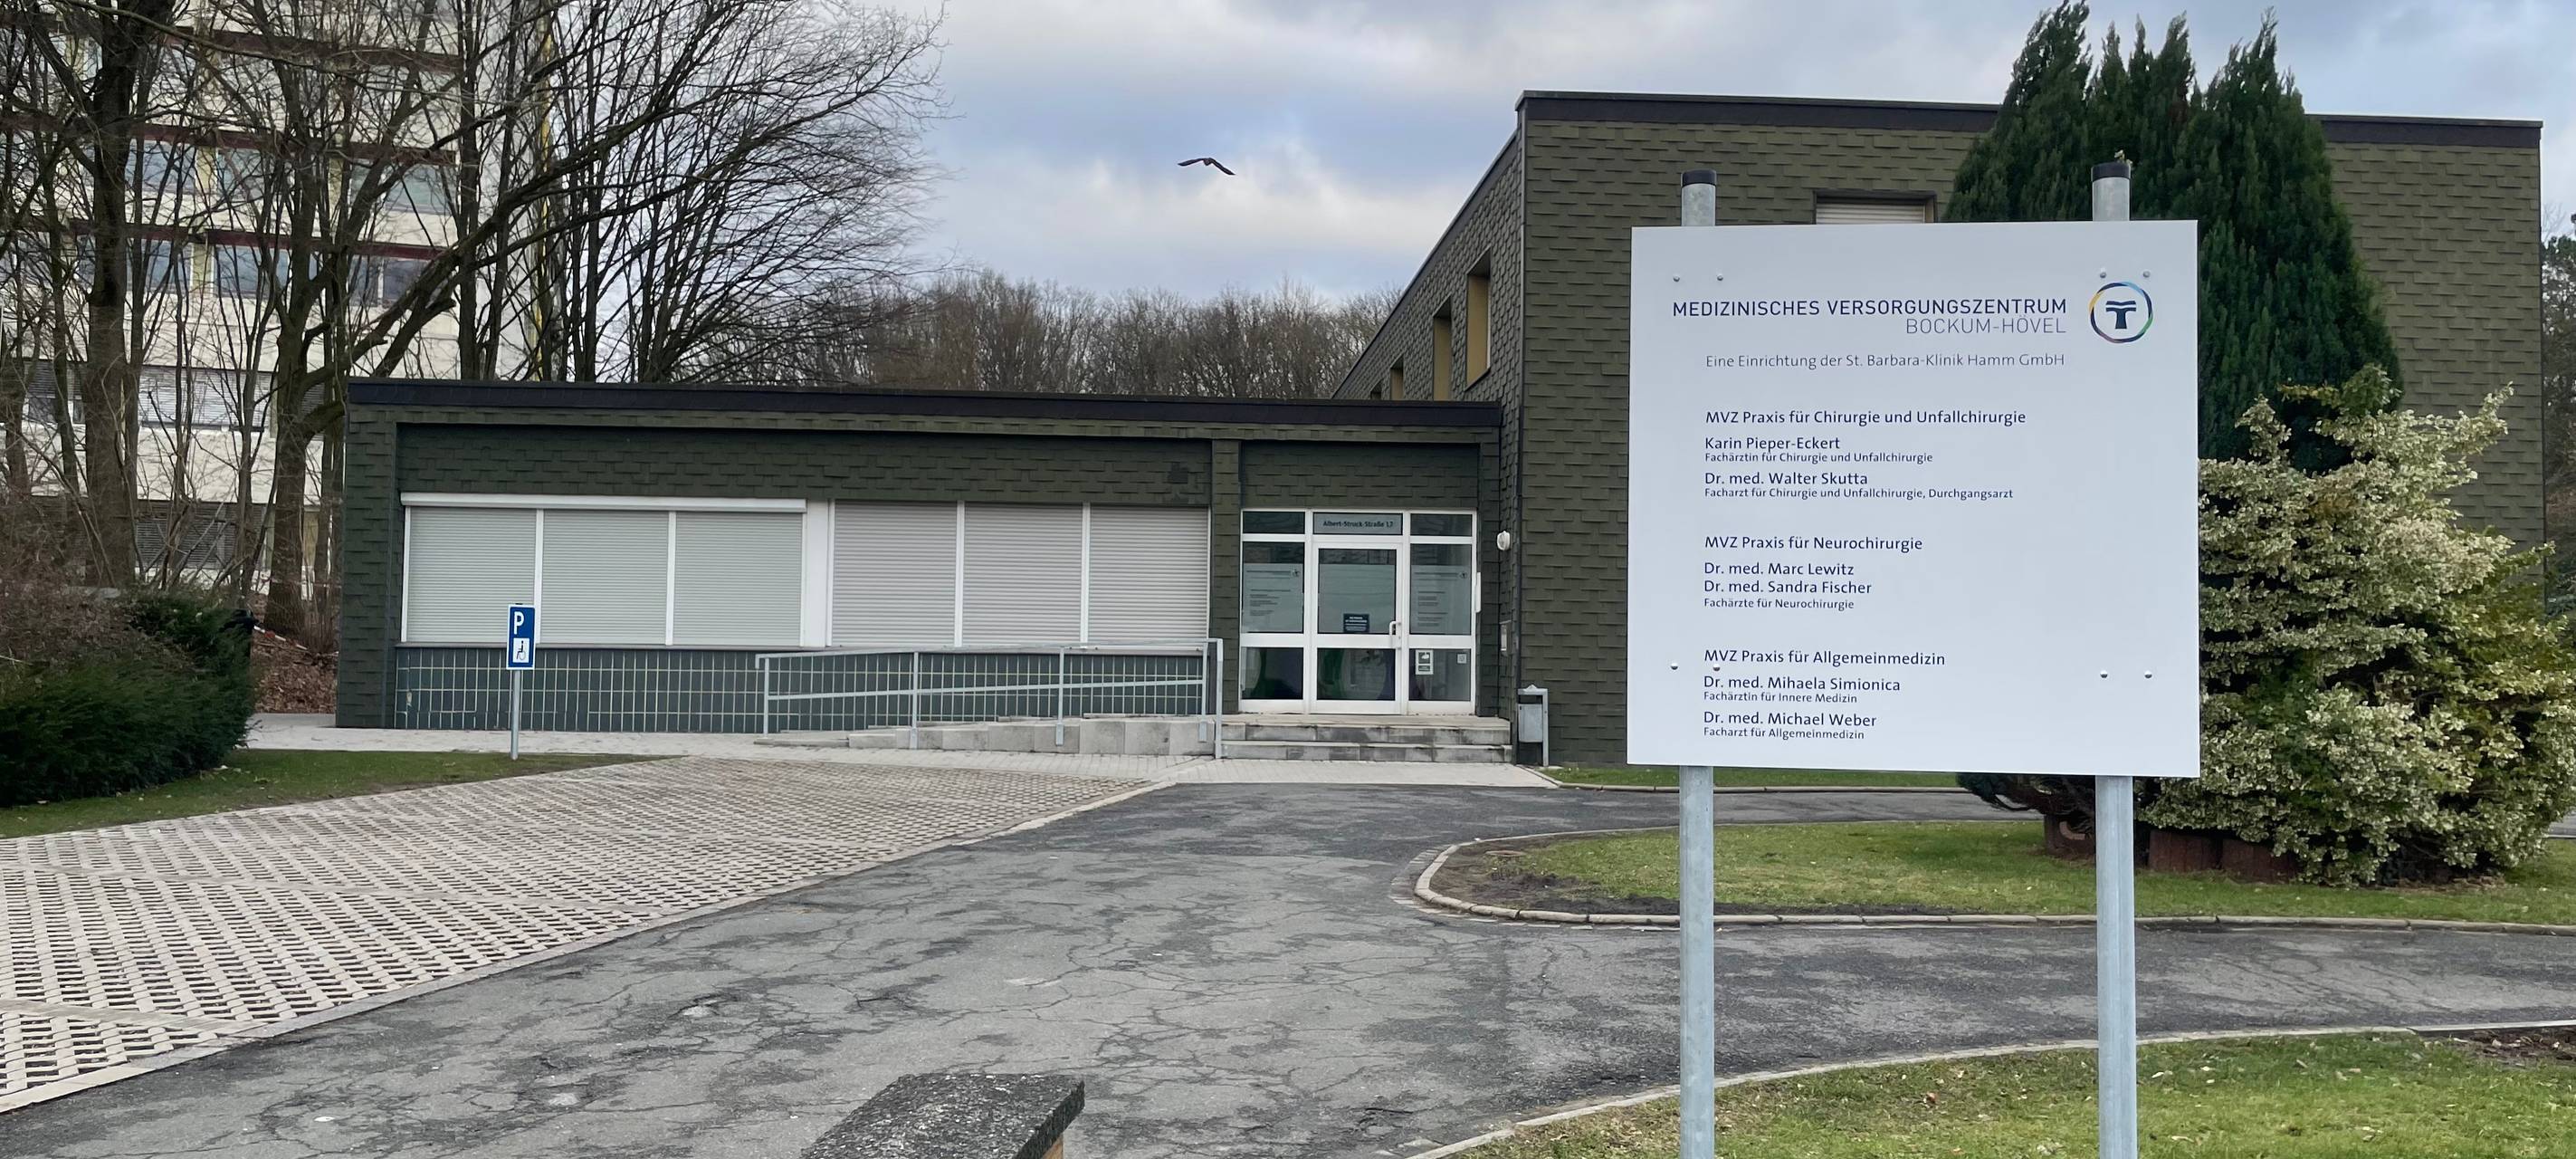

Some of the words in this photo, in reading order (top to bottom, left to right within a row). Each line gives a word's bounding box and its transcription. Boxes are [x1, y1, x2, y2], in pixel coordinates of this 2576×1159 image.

[1673, 300, 1820, 318] MEDIZINISCHES
[1827, 298, 2066, 316] VERSORGUNGSZENTRUM
[1906, 317, 2067, 334] BOCKUM-HÖVEL
[1706, 355, 1735, 368] Eine
[1738, 354, 1817, 371] Einrichtung
[1819, 354, 1843, 369] der
[1846, 354, 1864, 368] St.
[1867, 352, 1964, 368] Barbara-Klinik
[1967, 354, 2015, 368] Hamm
[2018, 352, 2065, 368] GmbH
[1705, 410, 1740, 424] MVZ
[1742, 410, 1786, 424] Praxis
[1788, 409, 1811, 424] für
[1813, 409, 1881, 427] Chirurgie
[1884, 409, 1913, 424] und
[1916, 409, 2027, 427] Unfallchirurgie
[1705, 436, 1742, 449] Karin
[1746, 436, 1841, 454] Pieper-Eckert
[1704, 451, 1759, 463] Fachärztin
[1761, 451, 1778, 463] für
[1779, 452, 1828, 465] Chirurgie
[1830, 451, 1851, 463] und
[1853, 451, 1933, 465] Unfallchirurgie
[1704, 472, 1725, 485] Dr.
[1729, 471, 1765, 485] med.
[1768, 471, 1818, 485] Walter
[1821, 470, 1868, 485] Skutta
[1704, 487, 1749, 500] Facharzt
[1751, 487, 1767, 500] für
[1769, 487, 1818, 501] Chirurgie
[1820, 488, 1841, 499] und
[1843, 487, 1926, 502] Unfallchirurgie,
[1928, 487, 2014, 502] Durchgangsarzt
[1704, 535, 1739, 549] MVZ
[1741, 535, 1785, 551] Praxis
[1788, 535, 1810, 550] für
[1813, 535, 1923, 554] Neurochirurgie
[1703, 561, 1725, 575] Dr.
[1728, 560, 1764, 576] med.
[1768, 561, 1804, 576] Marc
[1808, 562, 1855, 576] Lewitz
[1703, 580, 1724, 593] Dr.
[1728, 580, 1765, 593] med.
[1768, 578, 1818, 594] Sandra
[1821, 580, 1873, 594] Fischer
[1703, 597, 1755, 608] Fachärzte
[1756, 596, 1773, 608] für
[1774, 598, 1855, 612] Neurochirurgie
[513, 610, 525, 635] P
[1703, 648, 1738, 662] MVZ
[1741, 649, 1785, 666] Praxis
[1788, 649, 1810, 666] für
[1812, 650, 1945, 668] Allgemeinmedizin
[1703, 675, 1724, 688] Dr.
[1728, 675, 1763, 689] med.
[1767, 675, 1826, 690] Mihaela
[1829, 676, 1901, 691] Simionica
[1703, 691, 1758, 703] Fachärztin
[1760, 691, 1777, 703] für
[1778, 692, 1813, 703] Innere
[1815, 692, 1857, 704] Medizin
[1703, 711, 1724, 724] Dr.
[1728, 711, 1764, 724] med.
[1767, 709, 1825, 726] Michael
[1828, 713, 1877, 727] Weber
[1703, 726, 1749, 738] Facharzt
[1750, 726, 1767, 740] für
[1768, 727, 1865, 742] Allgemeinmedizin
